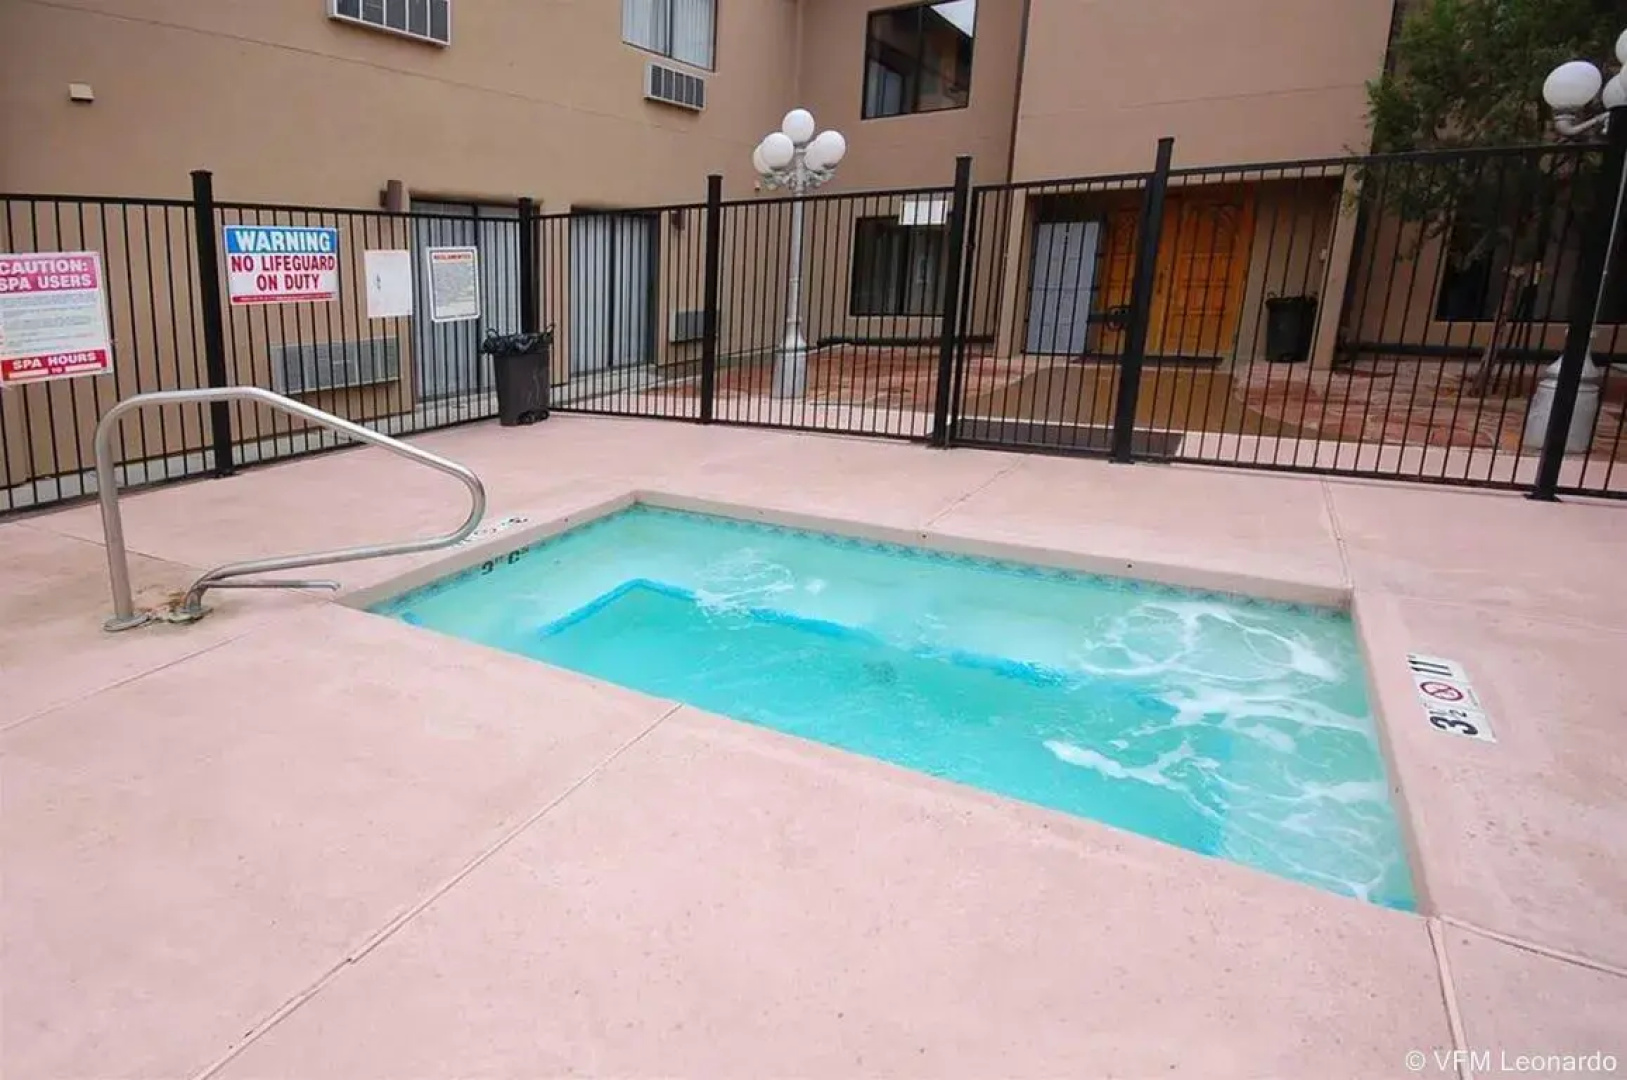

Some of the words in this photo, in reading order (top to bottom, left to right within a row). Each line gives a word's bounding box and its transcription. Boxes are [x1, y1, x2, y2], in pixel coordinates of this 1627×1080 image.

[235, 230, 331, 252] WARNING
[0, 259, 88, 275] CAUTION:
[231, 255, 254, 273] NO
[262, 255, 335, 271] LIFEGUARD
[0, 276, 32, 291] SPA
[38, 273, 92, 289] USERS
[256, 274, 278, 292] ON
[284, 273, 320, 290] DUTY
[12, 358, 42, 371] SPA
[47, 351, 97, 367] HOURS
